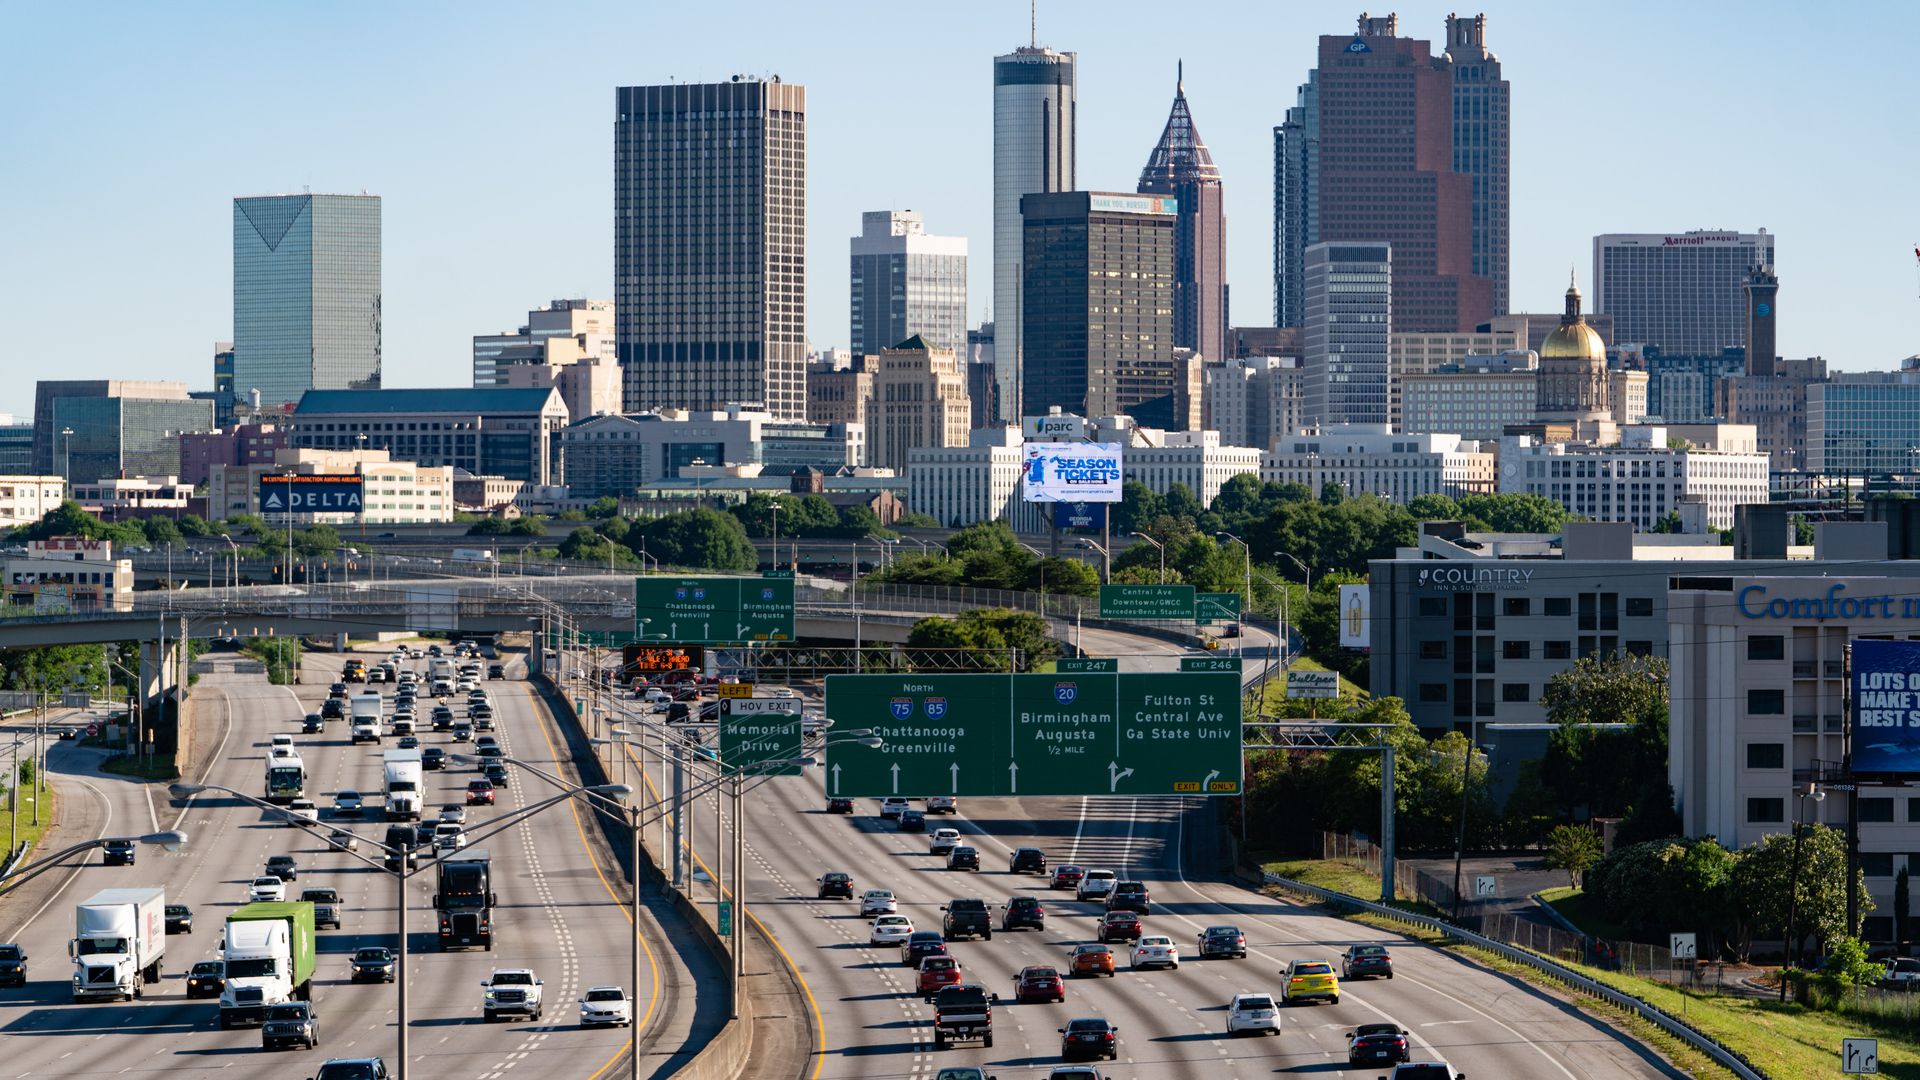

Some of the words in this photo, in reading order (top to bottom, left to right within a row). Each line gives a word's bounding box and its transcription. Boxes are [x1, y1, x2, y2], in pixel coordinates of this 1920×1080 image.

[1350, 43, 1366, 52] GP
[1016, 54, 1057, 65] WESTIN
[1662, 236, 1703, 246] Marriott
[1045, 422, 1073, 434] parc
[1057, 459, 1116, 469] SEASON
[1054, 469, 1120, 480] TICKETS
[290, 492, 361, 507] DELTA
[35, 540, 101, 550] I.B.E.W.
[1433, 568, 1534, 584] COUNTRY
[665, 602, 715, 611] Chattanooga
[1113, 598, 1181, 606] Downtown/GWCC
[1738, 584, 1895, 620] Comfort
[743, 603, 791, 612] Birmingham
[1160, 607, 1192, 615] Stadium
[752, 612, 785, 620] Augusta
[1086, 662, 1107, 670] 247
[1210, 661, 1232, 669] 246
[1288, 673, 1336, 686] Bullpen
[1860, 673, 1903, 690] LOTS
[722, 687, 748, 695] LEFT
[904, 684, 933, 692] NORTH
[1059, 689, 1074, 699] 20
[1145, 695, 1191, 705] Fulton
[1199, 695, 1215, 705] St
[1860, 691, 1910, 708] MAKE
[740, 702, 762, 711] HOV
[768, 702, 791, 711] EXIT
[895, 704, 909, 715] 75
[928, 704, 943, 715] 85
[1021, 713, 1111, 726] Birmingham
[1135, 712, 1189, 722] Central
[1197, 712, 1224, 722] Ave
[1860, 710, 1905, 726] BEST
[727, 724, 794, 735] Memorial
[873, 726, 965, 739] Chattanooga
[1127, 729, 1144, 739] Ga
[1151, 729, 1190, 739] State
[1198, 728, 1231, 739] Univ
[1035, 730, 1096, 743] Augusta
[742, 741, 780, 751] Drive
[881, 743, 955, 753] Greenville
